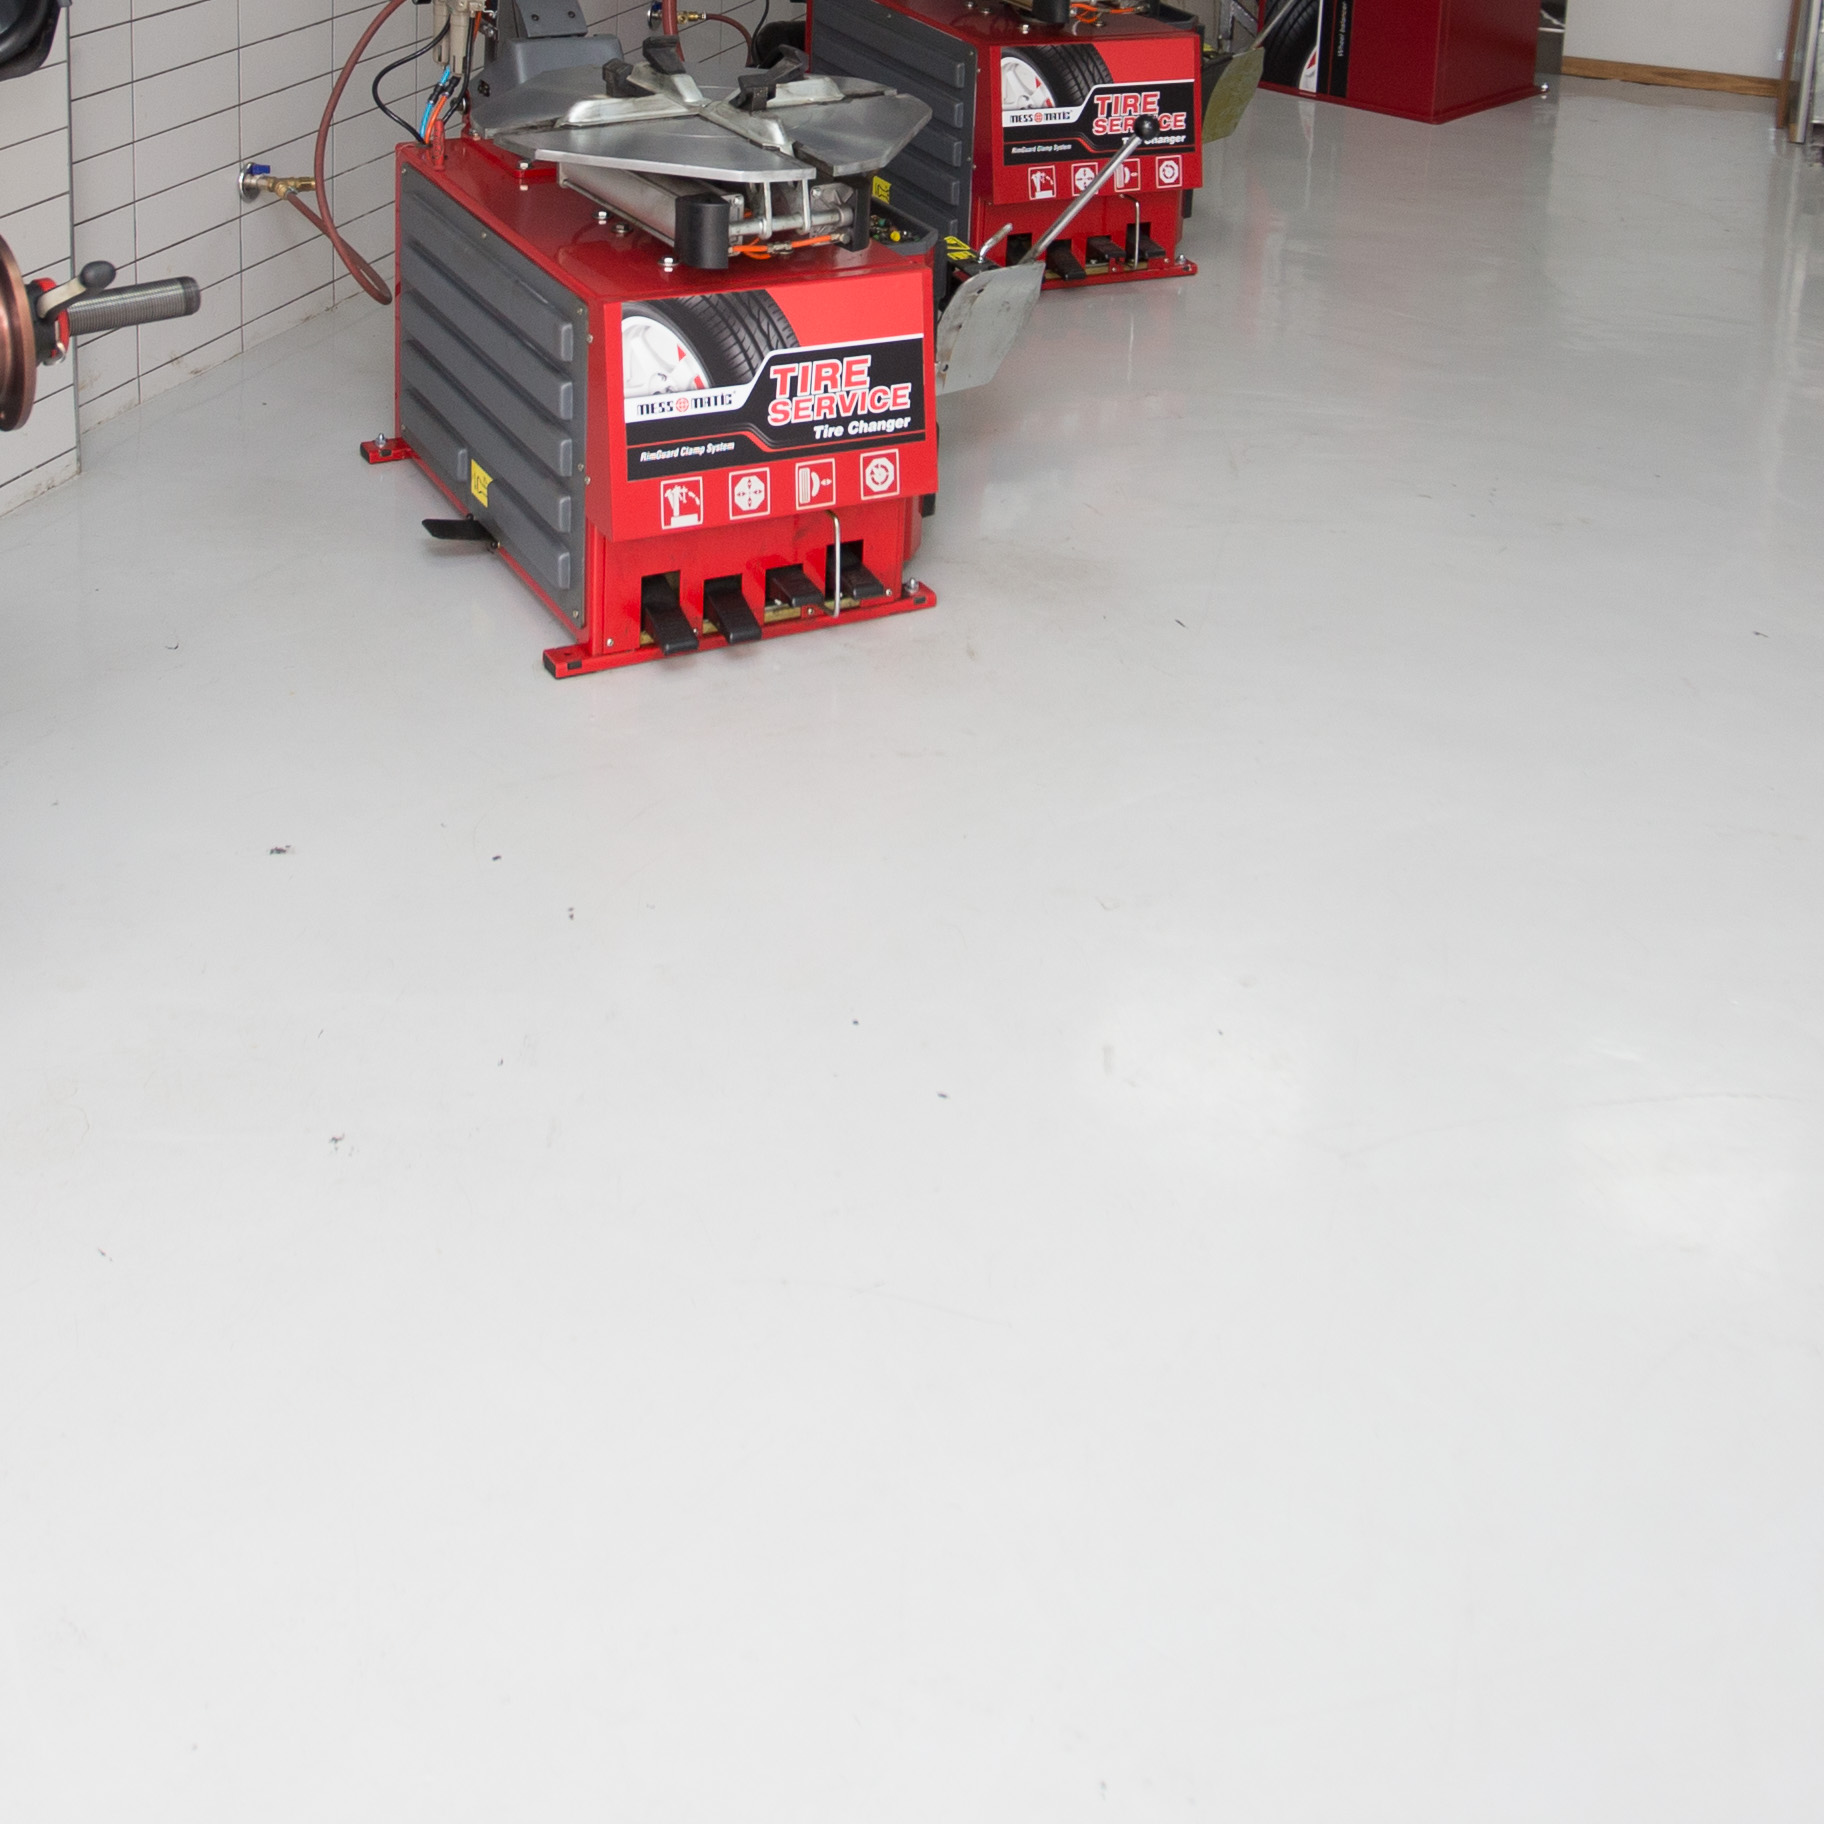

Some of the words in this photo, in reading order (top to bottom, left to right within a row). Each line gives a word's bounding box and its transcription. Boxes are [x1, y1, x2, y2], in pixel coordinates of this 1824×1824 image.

[1094, 91, 1160, 116] TIRE
[1092, 112, 1186, 136] SERCE
[770, 355, 871, 399] TIRE
[767, 382, 912, 426] SERVICE
[813, 424, 845, 439] Tire
[847, 417, 911, 435] Changer
